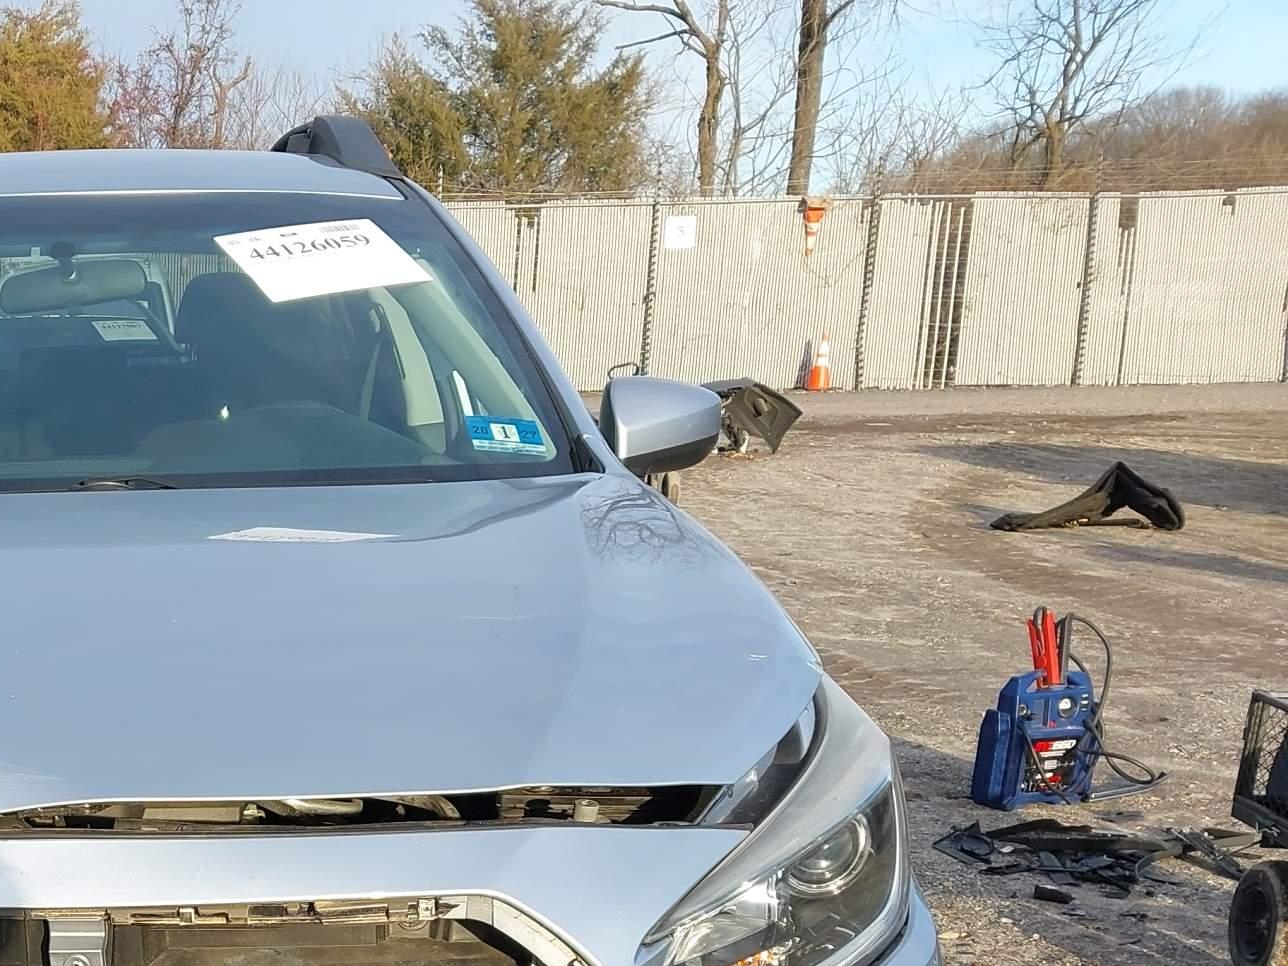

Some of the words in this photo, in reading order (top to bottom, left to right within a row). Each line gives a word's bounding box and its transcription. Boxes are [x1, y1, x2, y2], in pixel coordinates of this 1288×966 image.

[249, 234, 371, 260] 44126059
[472, 425, 488, 435] 20
[500, 426, 511, 439] 1
[521, 430, 537, 439] 27
